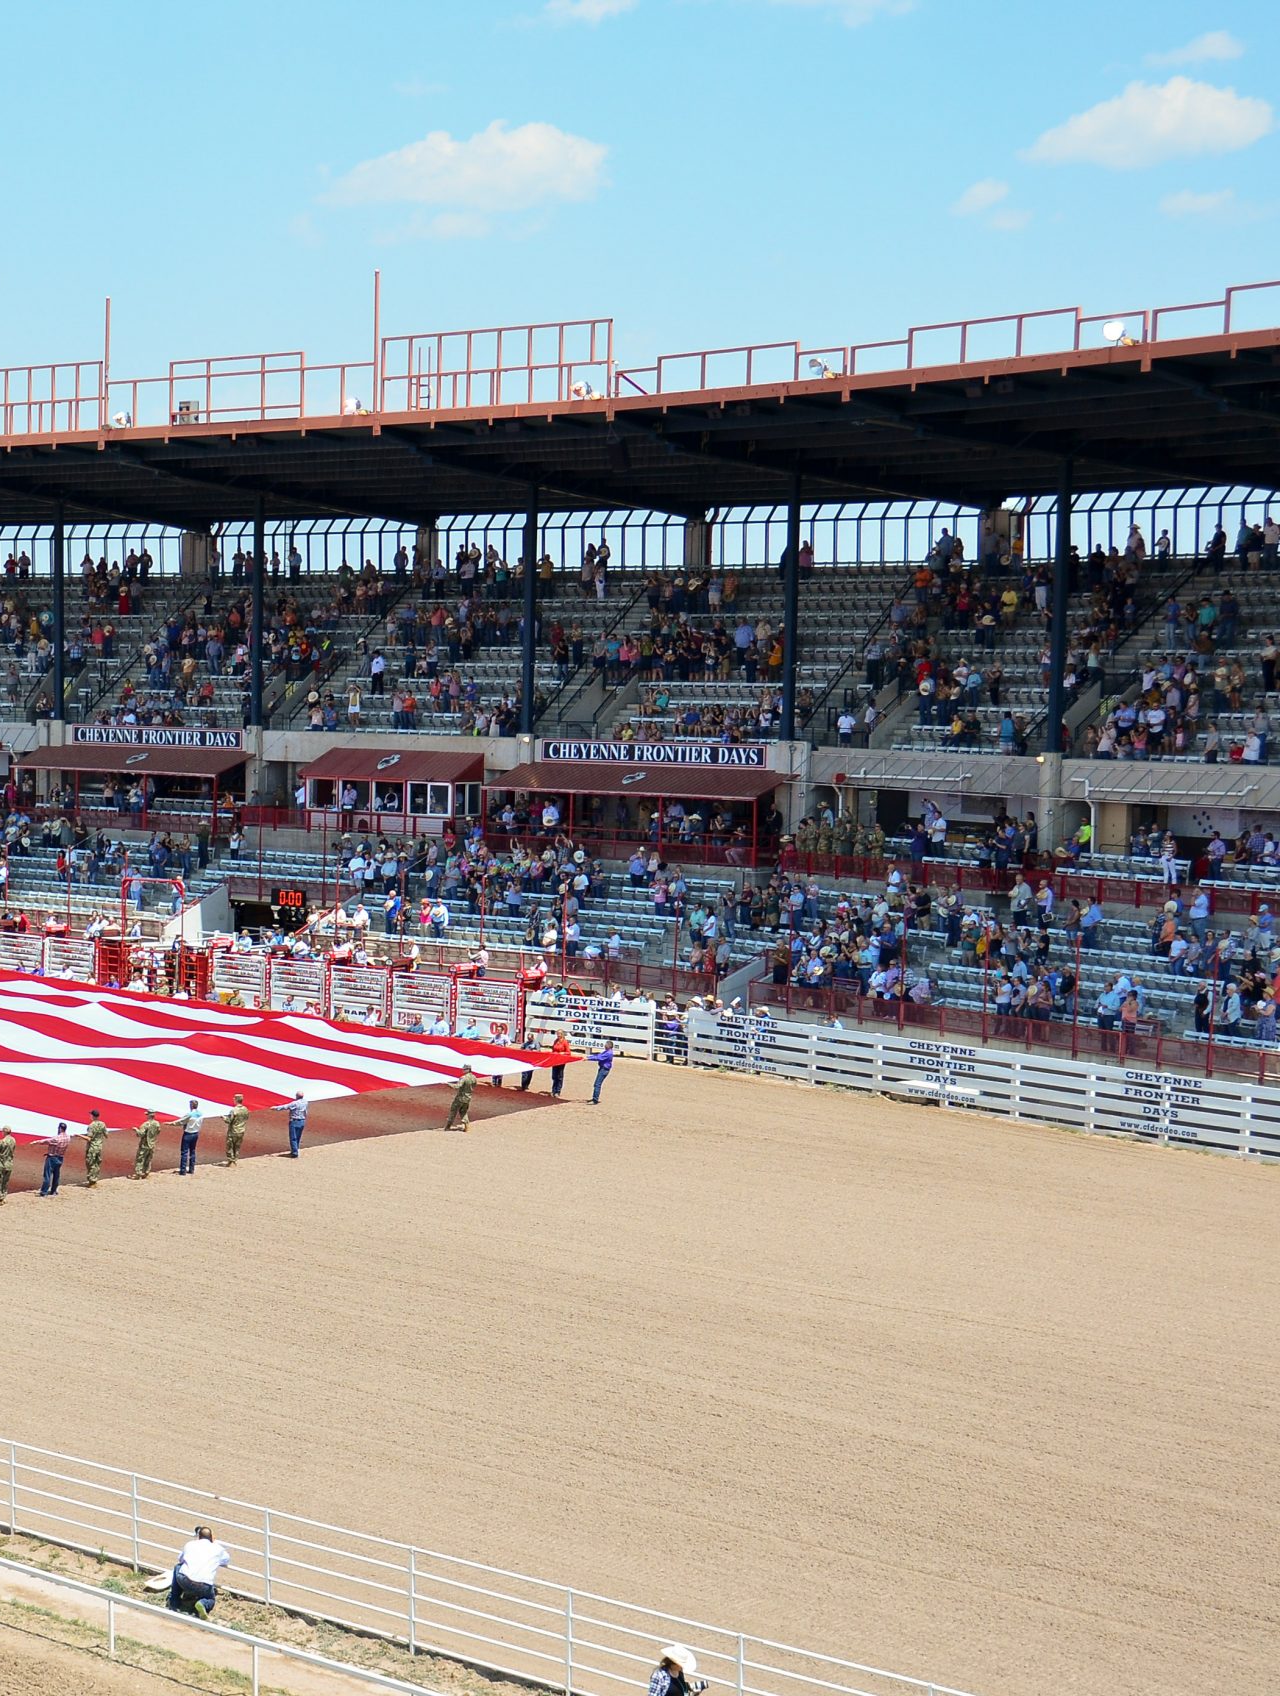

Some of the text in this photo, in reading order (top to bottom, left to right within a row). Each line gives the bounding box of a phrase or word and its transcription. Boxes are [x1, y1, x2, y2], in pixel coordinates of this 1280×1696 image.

[77, 727, 236, 747] CHEYENNE FRONTIER DAYS
[549, 742, 758, 765] CHEYENNE FRONTIER DAYS
[254, 995, 261, 1007] 5
[558, 996, 621, 1009] CHEYENNE
[314, 1002, 321, 1015] 6
[375, 1009, 383, 1022] 7
[557, 1010, 620, 1022] FRONTIER
[720, 1015, 778, 1029] CHEYENNE
[572, 1024, 602, 1034] DAYS
[720, 1029, 777, 1043] FRONTIER
[733, 1044, 760, 1055] DAYS
[909, 1041, 976, 1057] CHEYENNE
[910, 1056, 975, 1072] FRONTIER
[926, 1074, 957, 1086] DAYS
[1125, 1071, 1202, 1088] CHEYENNE
[908, 1087, 976, 1103] www.cfdrodeo.com
[1124, 1088, 1200, 1105] FRONTIER
[1142, 1106, 1178, 1118] DAYS
[1120, 1121, 1198, 1138] www.cfdrodeo.com
